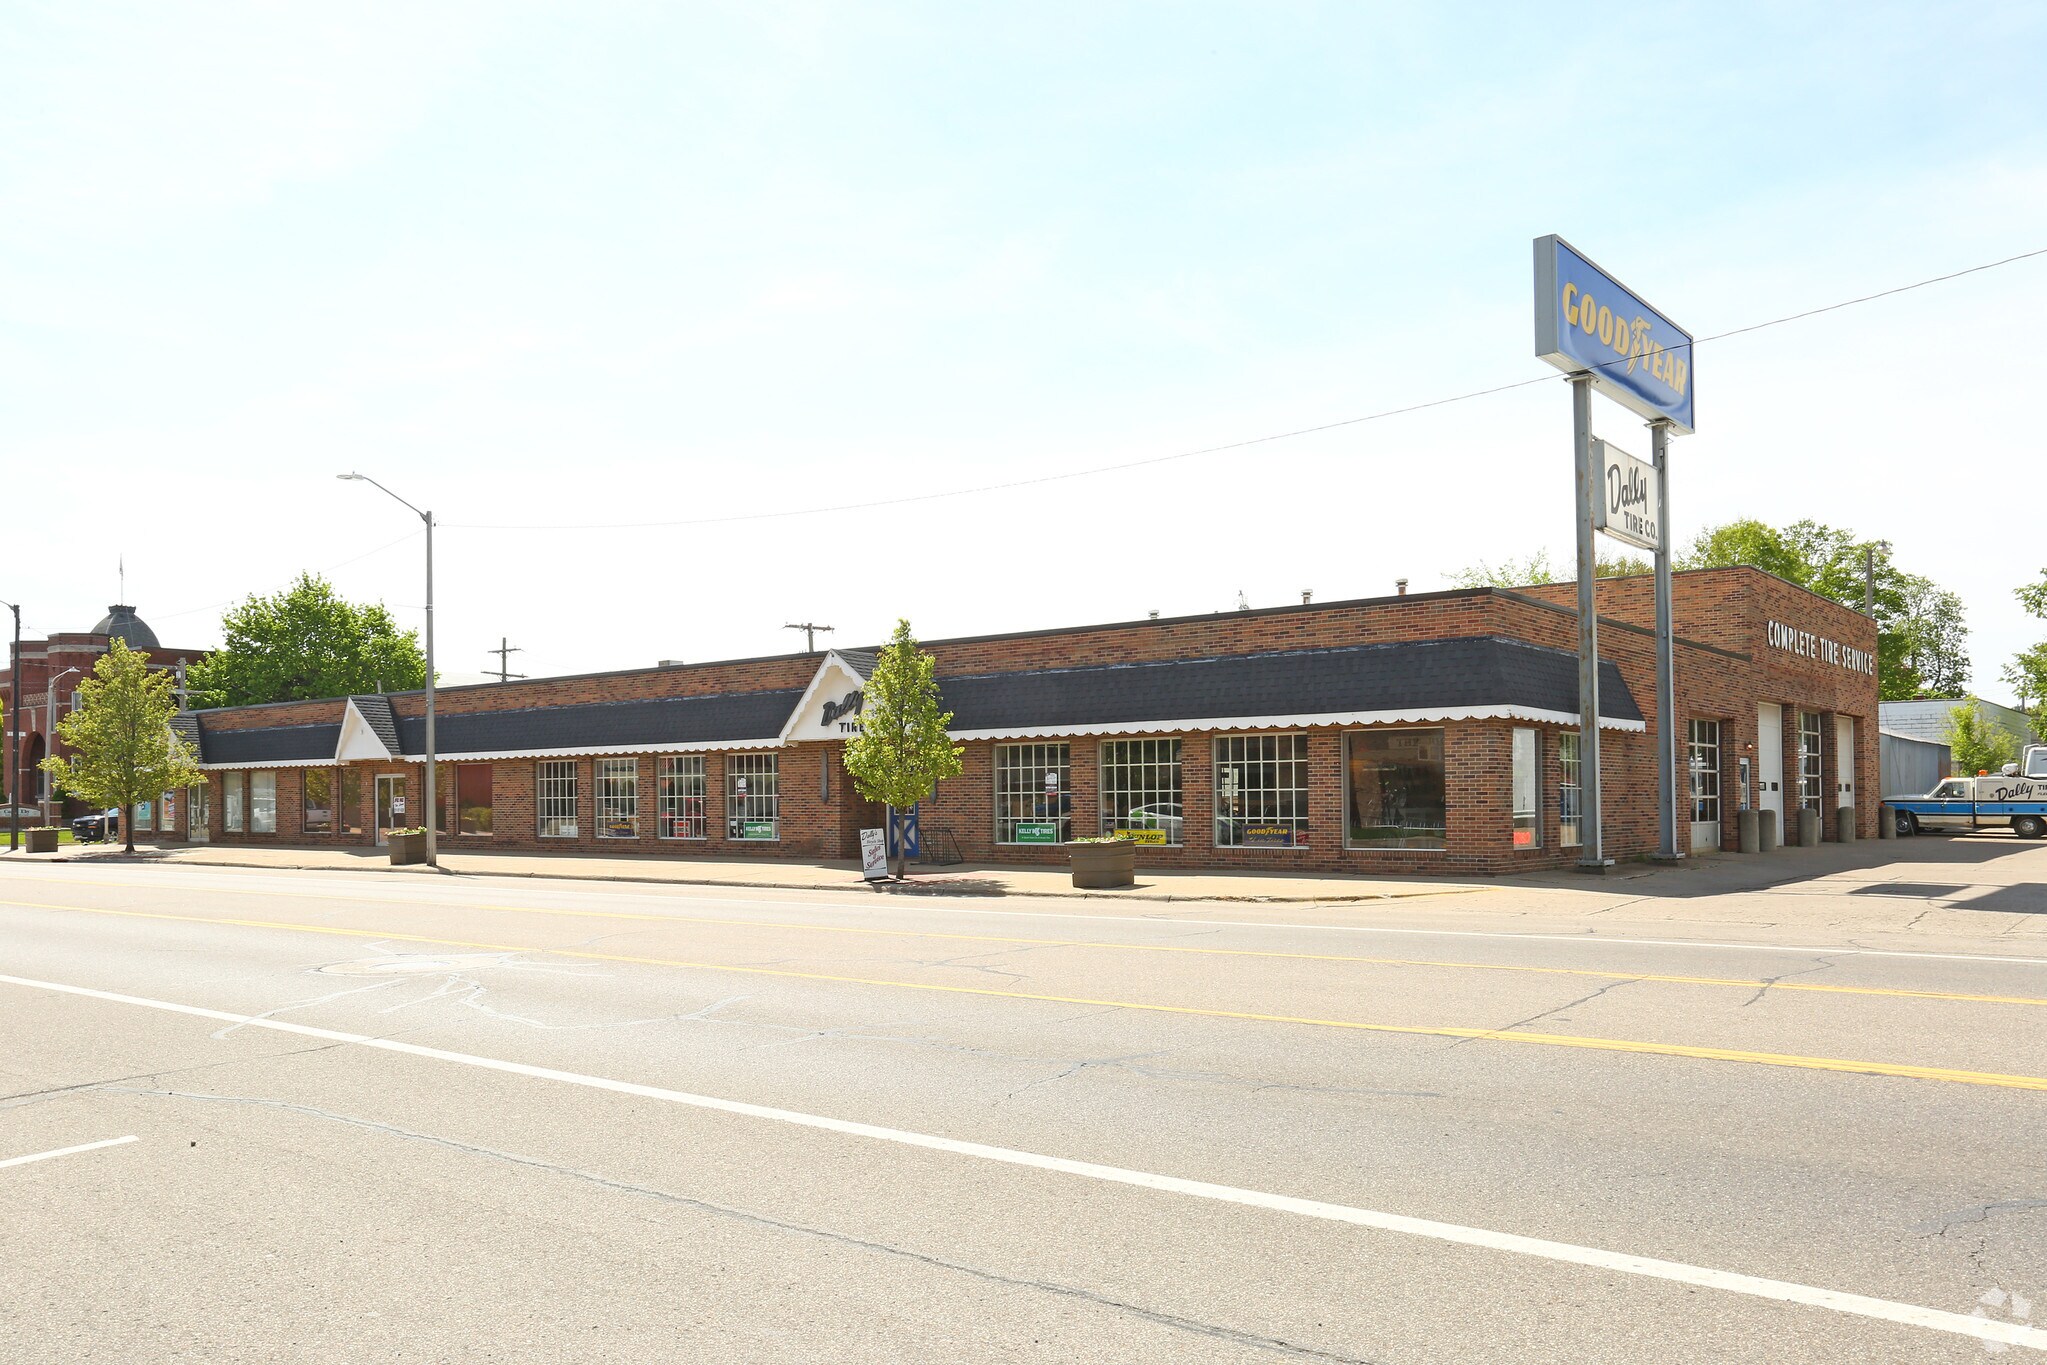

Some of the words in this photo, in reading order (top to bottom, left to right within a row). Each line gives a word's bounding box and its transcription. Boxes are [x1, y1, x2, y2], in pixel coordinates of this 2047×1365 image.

[1562, 282, 1687, 397] GOODYEAR
[1607, 464, 1647, 515] Dally
[1624, 510, 1643, 535] TIRE
[1645, 520, 1658, 541] CO.
[1767, 620, 1816, 659] COMPLETE
[1820, 637, 1839, 666] TIRE
[1842, 645, 1873, 676] SERVICE
[821, 690, 865, 726] Dally
[838, 722, 865, 733] TIRE
[1995, 782, 2035, 801] Dally
[1246, 827, 1288, 835] GOODYEAR
